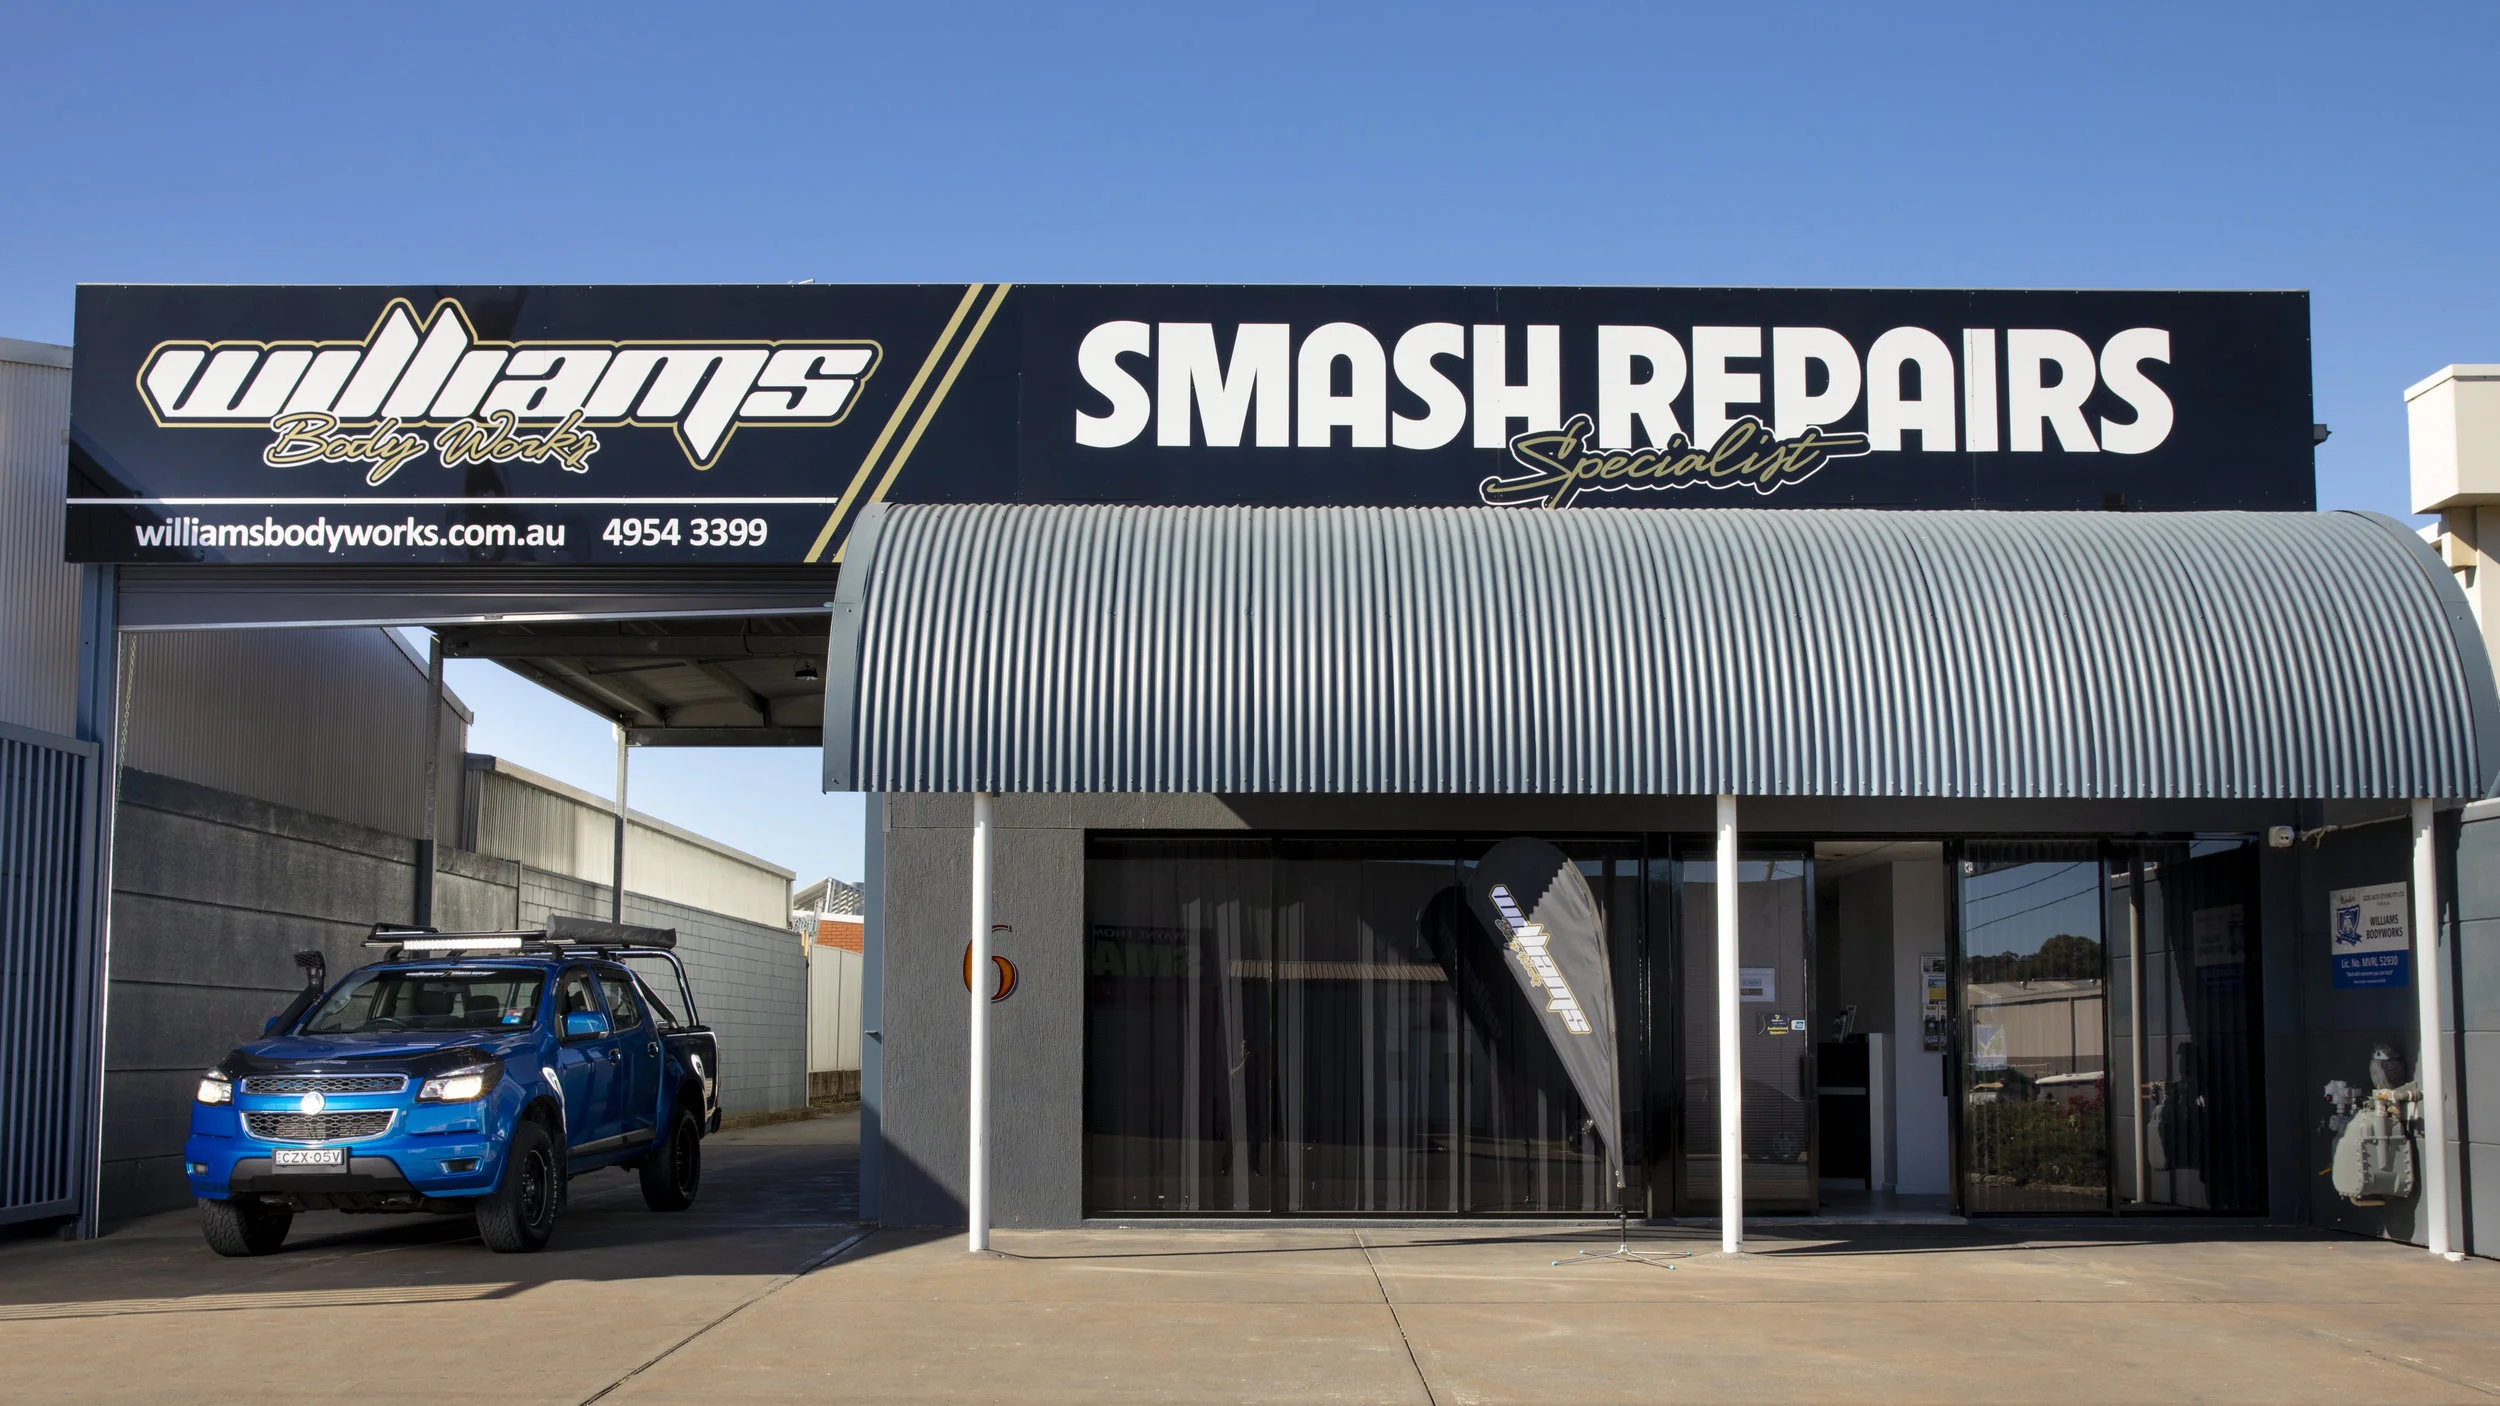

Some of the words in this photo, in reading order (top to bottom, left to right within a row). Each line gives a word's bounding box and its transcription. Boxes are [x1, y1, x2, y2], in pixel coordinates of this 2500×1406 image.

[146, 306, 874, 461] williams
[1075, 321, 1560, 449] SMASH
[1600, 325, 2174, 455] REPAIRS
[265, 411, 427, 484] Body
[435, 408, 598, 472] Works
[1486, 420, 1865, 508] Specialist
[135, 516, 565, 553] williamsbodyworks.com.au
[602, 518, 681, 546] 4954
[689, 518, 768, 546] 3399
[2366, 927, 2403, 940] BODYWORKS
[2369, 914, 2399, 926] WILLIAMS
